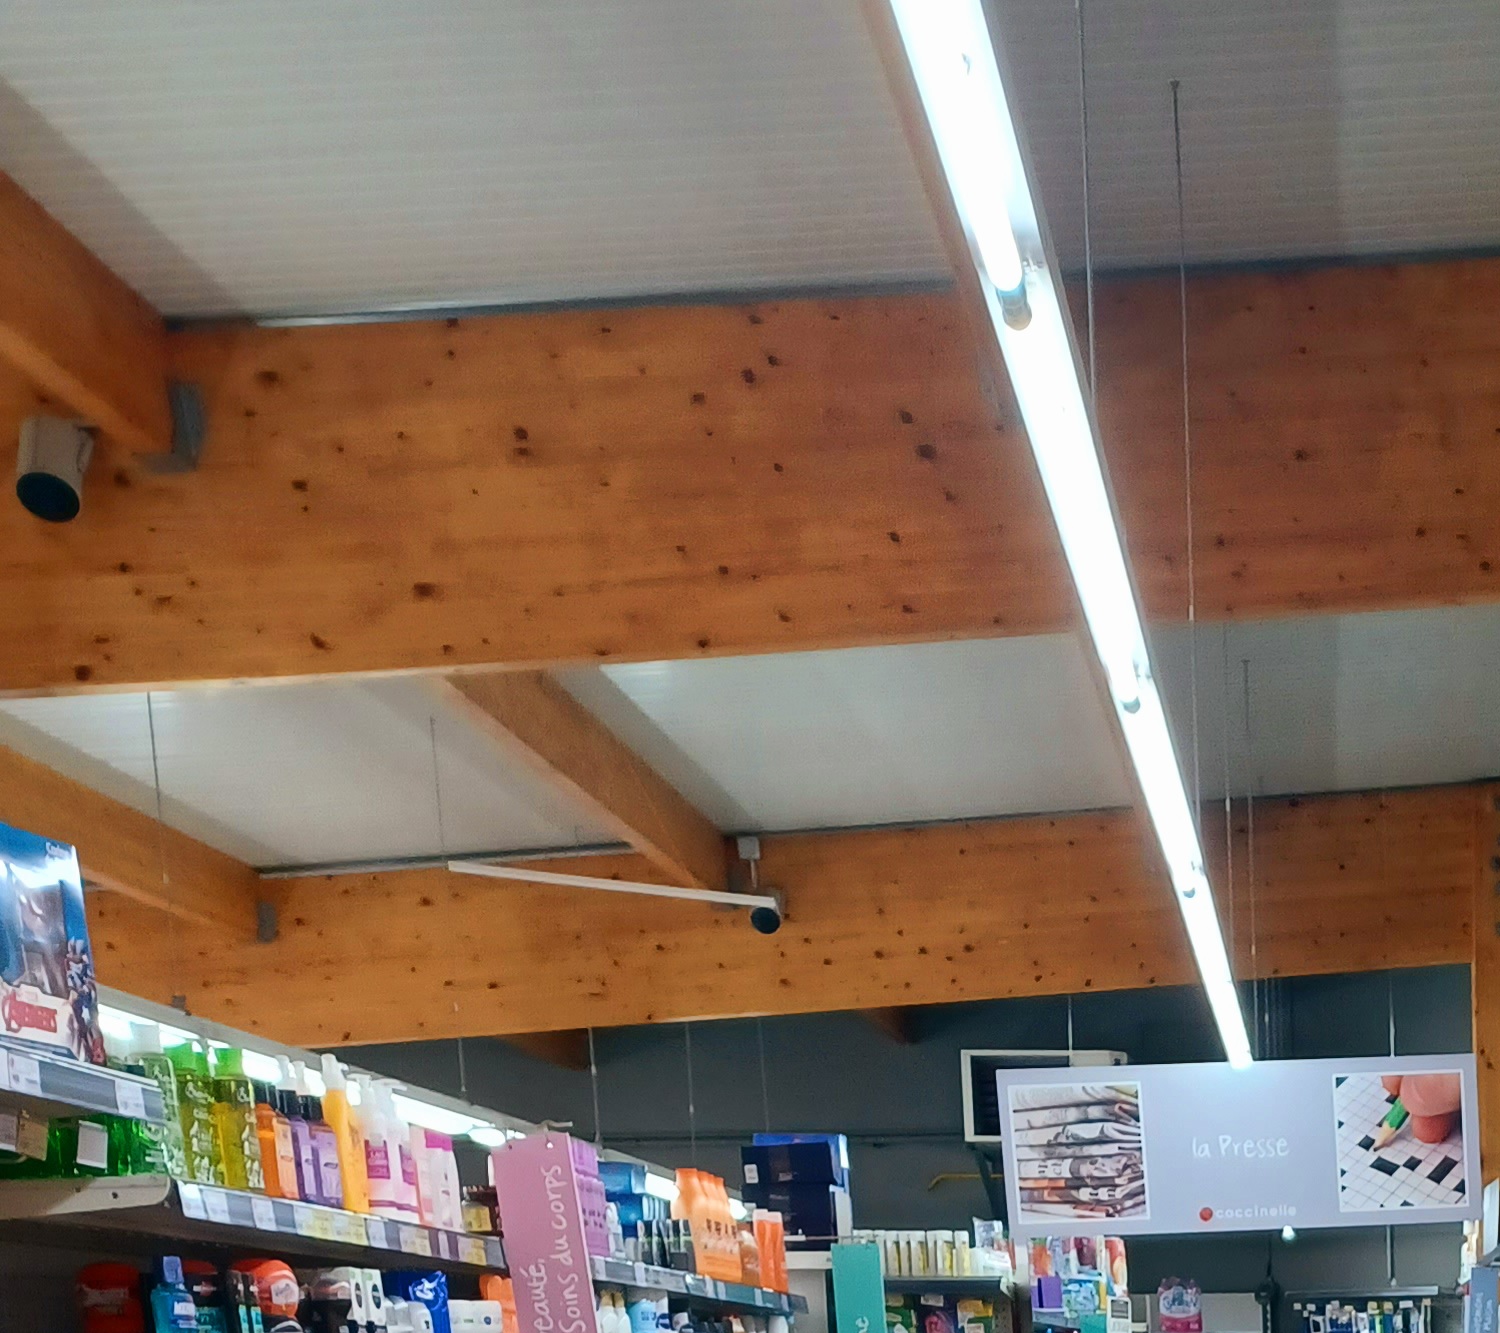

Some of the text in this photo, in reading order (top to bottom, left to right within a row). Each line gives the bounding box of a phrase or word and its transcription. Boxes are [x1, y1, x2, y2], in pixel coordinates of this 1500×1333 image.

[1192, 1134, 1290, 1159] la Presse
[541, 1163, 569, 1230] corps
[553, 1230, 574, 1267] du
[557, 1270, 588, 1333] Soins
